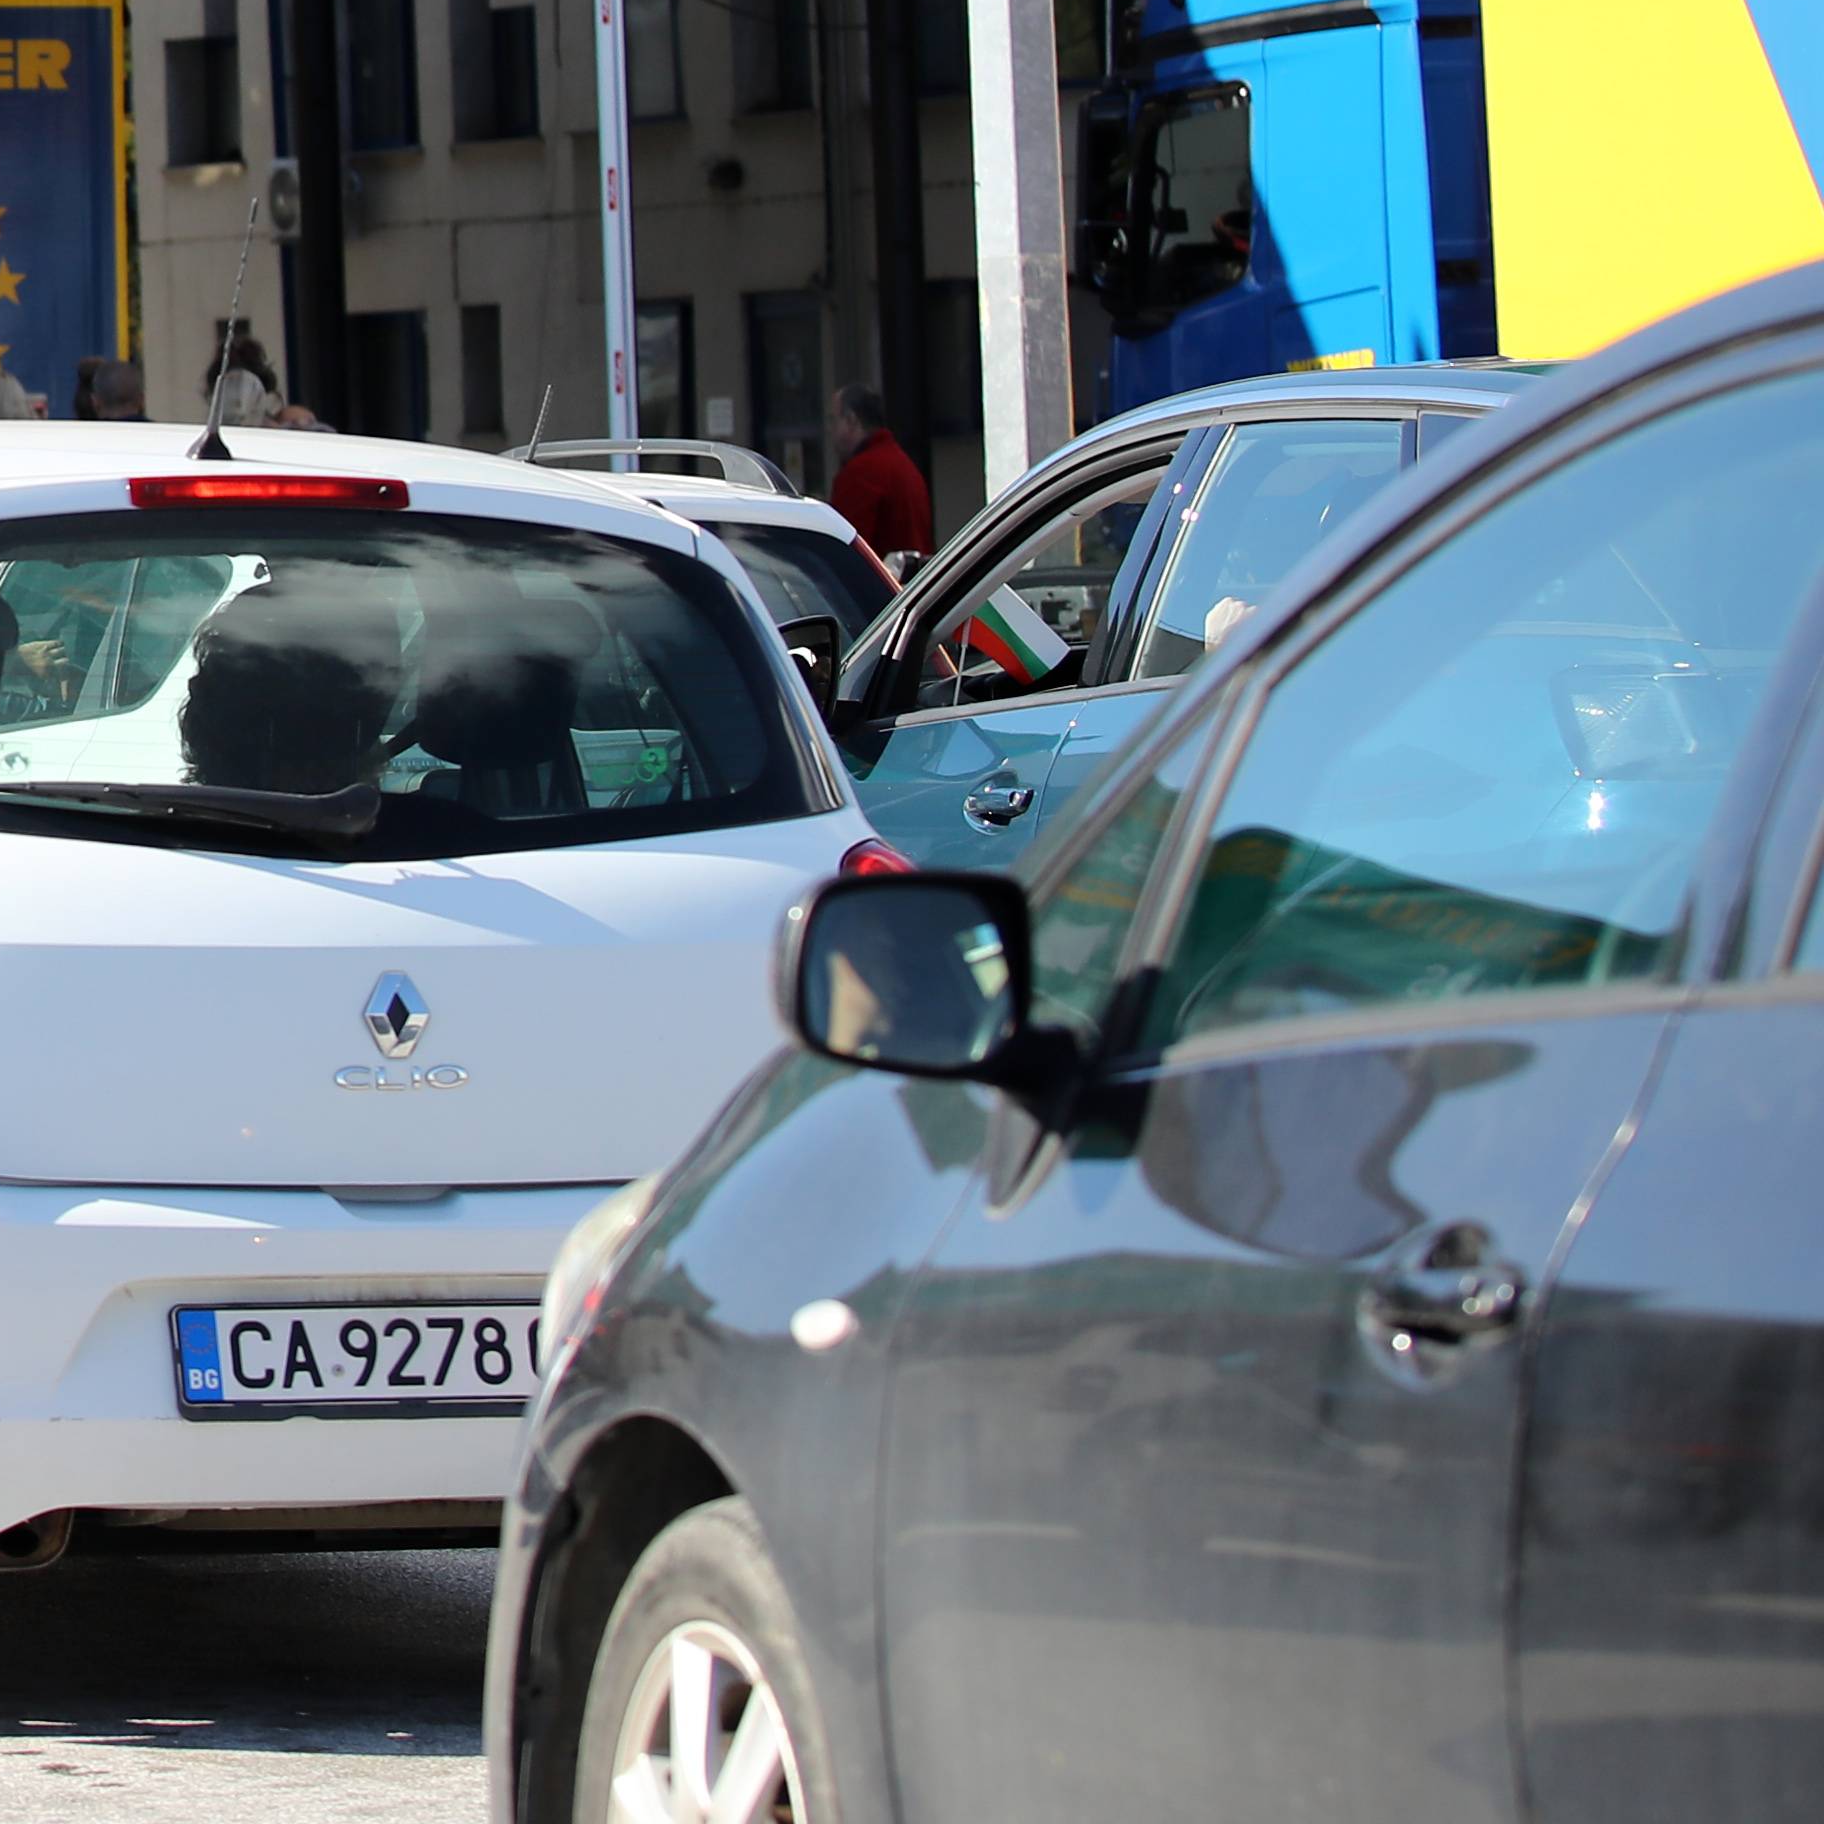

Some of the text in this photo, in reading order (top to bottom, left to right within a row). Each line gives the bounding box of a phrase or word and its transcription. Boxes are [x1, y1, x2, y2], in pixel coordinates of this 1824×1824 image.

[333, 1063, 471, 1092] CLIO
[229, 1320, 324, 1389] CA
[339, 1317, 513, 1387] 9278
[188, 1368, 219, 1391] BG
